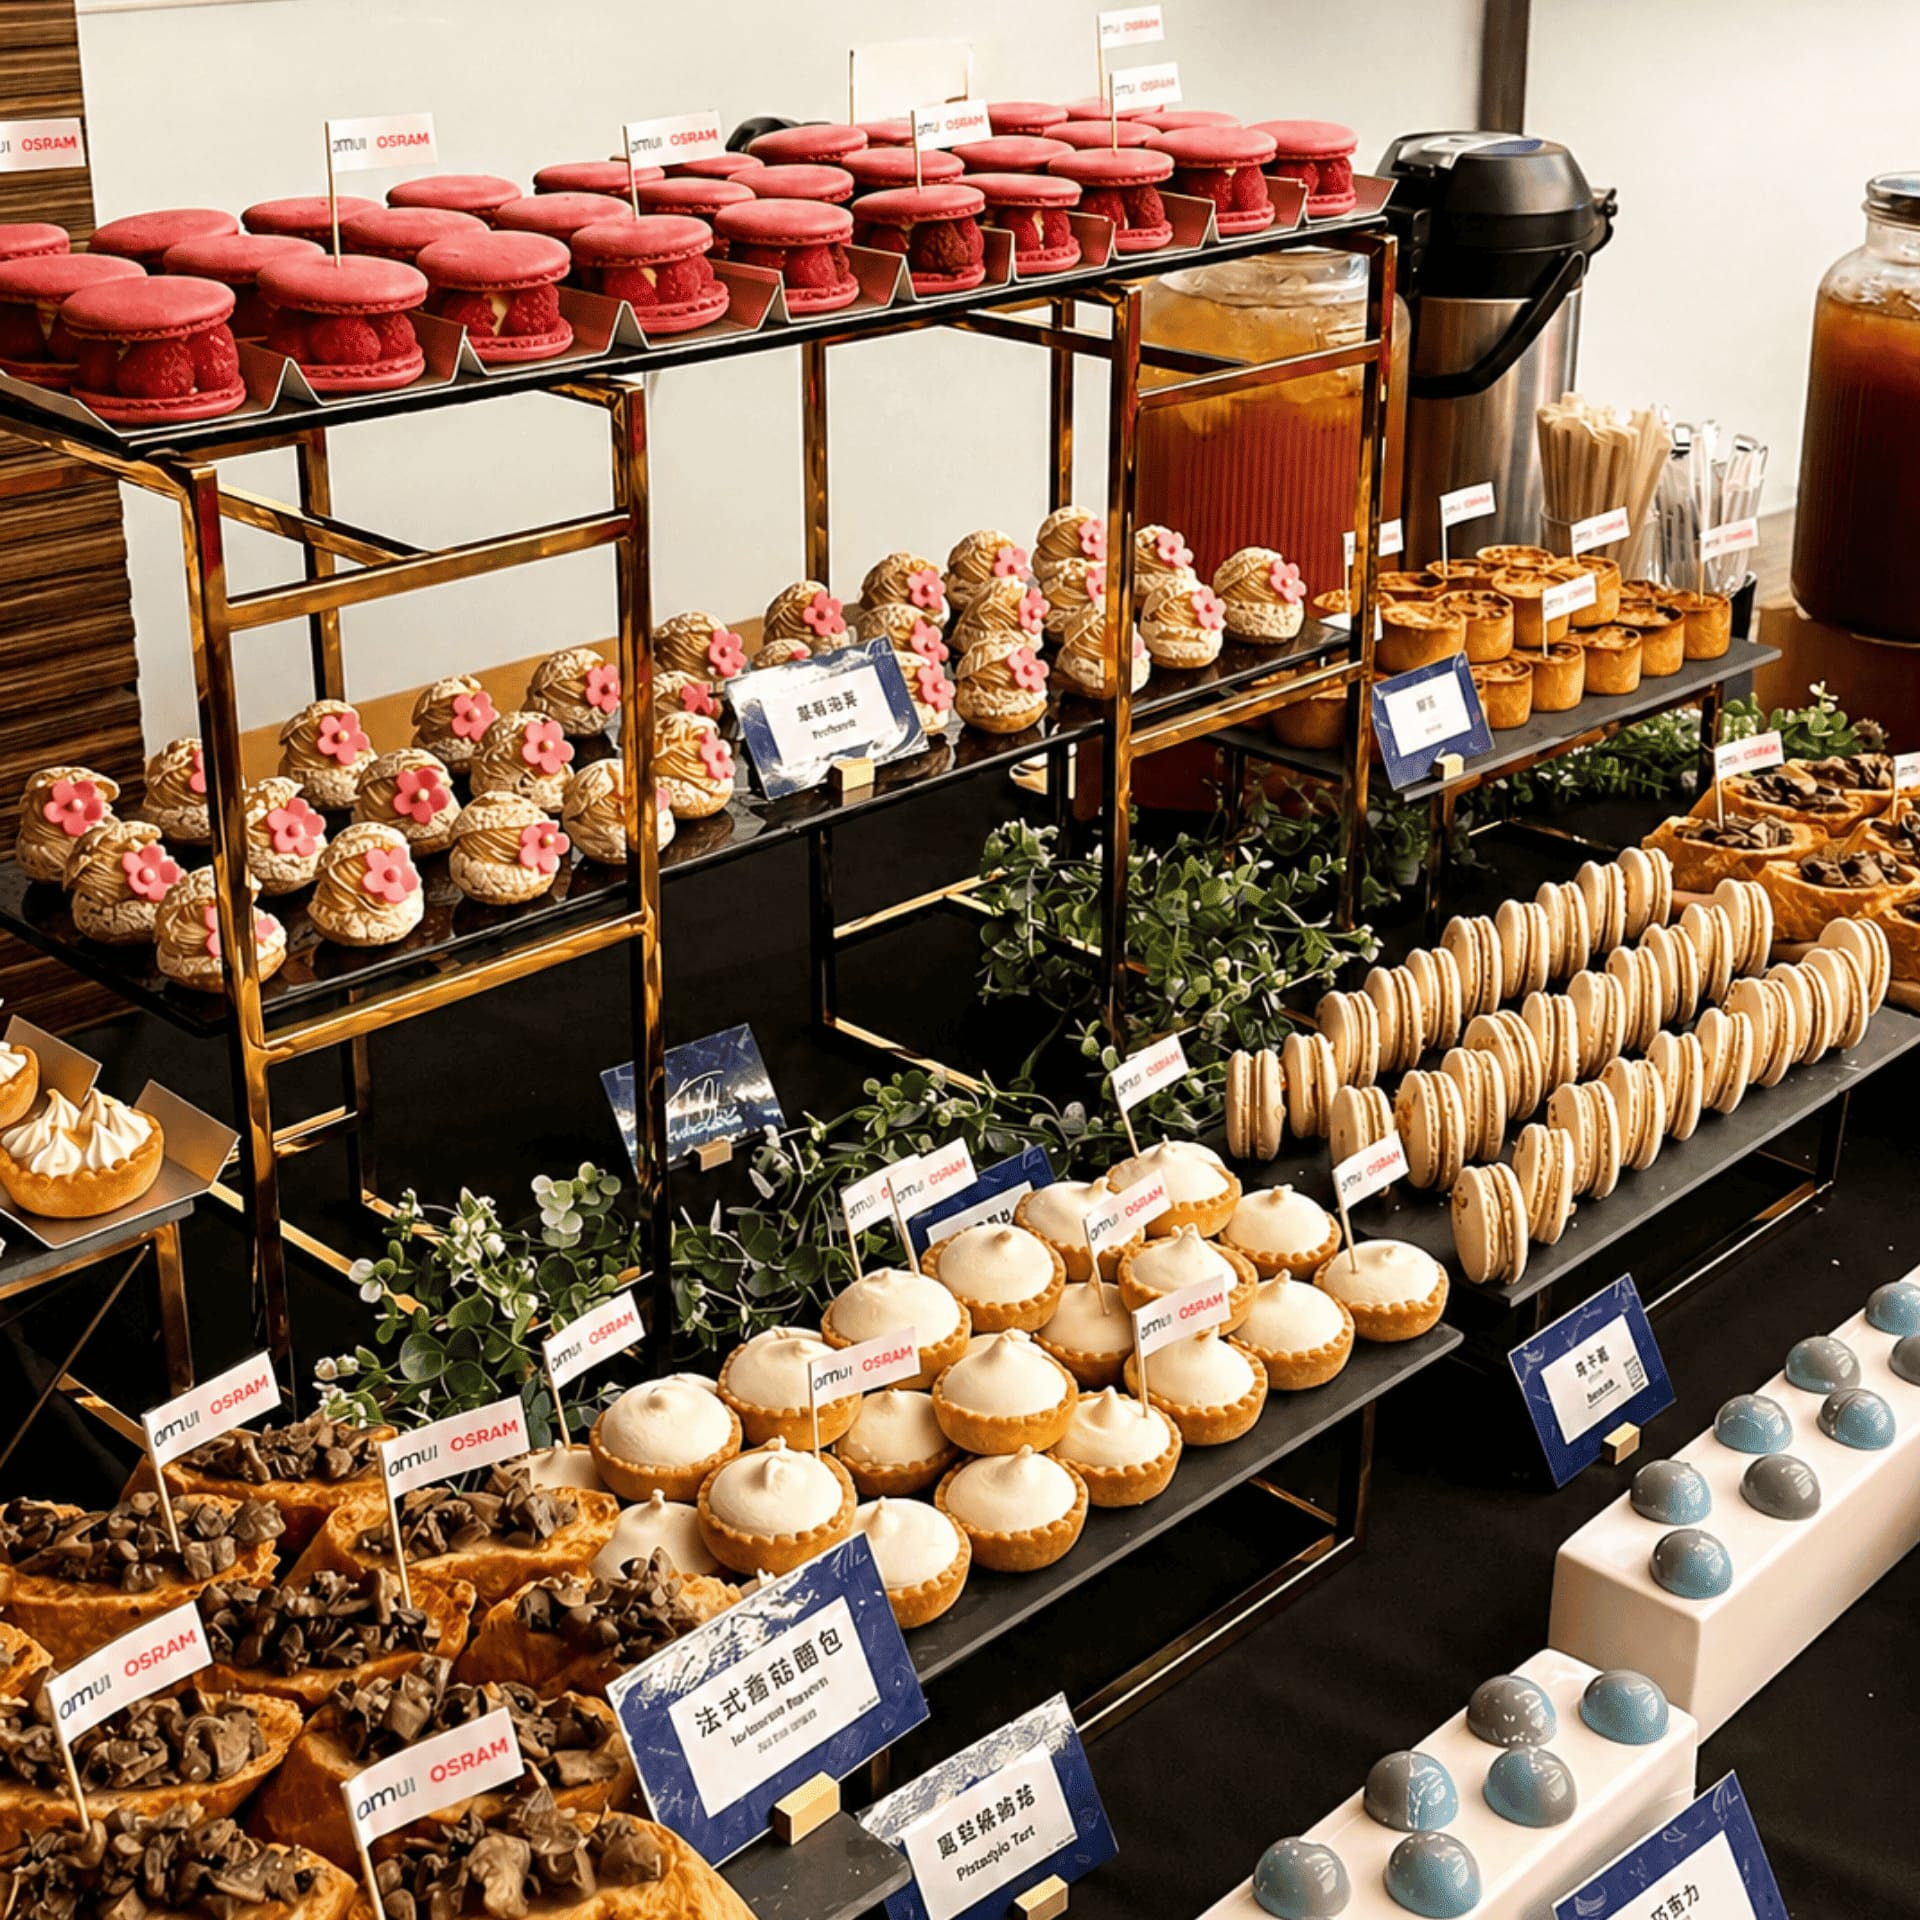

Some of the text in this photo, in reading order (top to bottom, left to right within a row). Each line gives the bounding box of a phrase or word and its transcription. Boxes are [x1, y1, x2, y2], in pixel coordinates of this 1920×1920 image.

[22, 135, 77, 152] OSRAM
[377, 132, 429, 149] OSRAM
[670, 128, 717, 146] OSRAM
[1178, 1292, 1224, 1320] OSRAM
[588, 1311, 634, 1344] OSRAM
[863, 1345, 912, 1372] OSRAM
[210, 1374, 268, 1415] OSRAM
[450, 1419, 518, 1452] OSRAM
[124, 1629, 197, 1677] OSRAM
[430, 1736, 509, 1783] OSRAM
